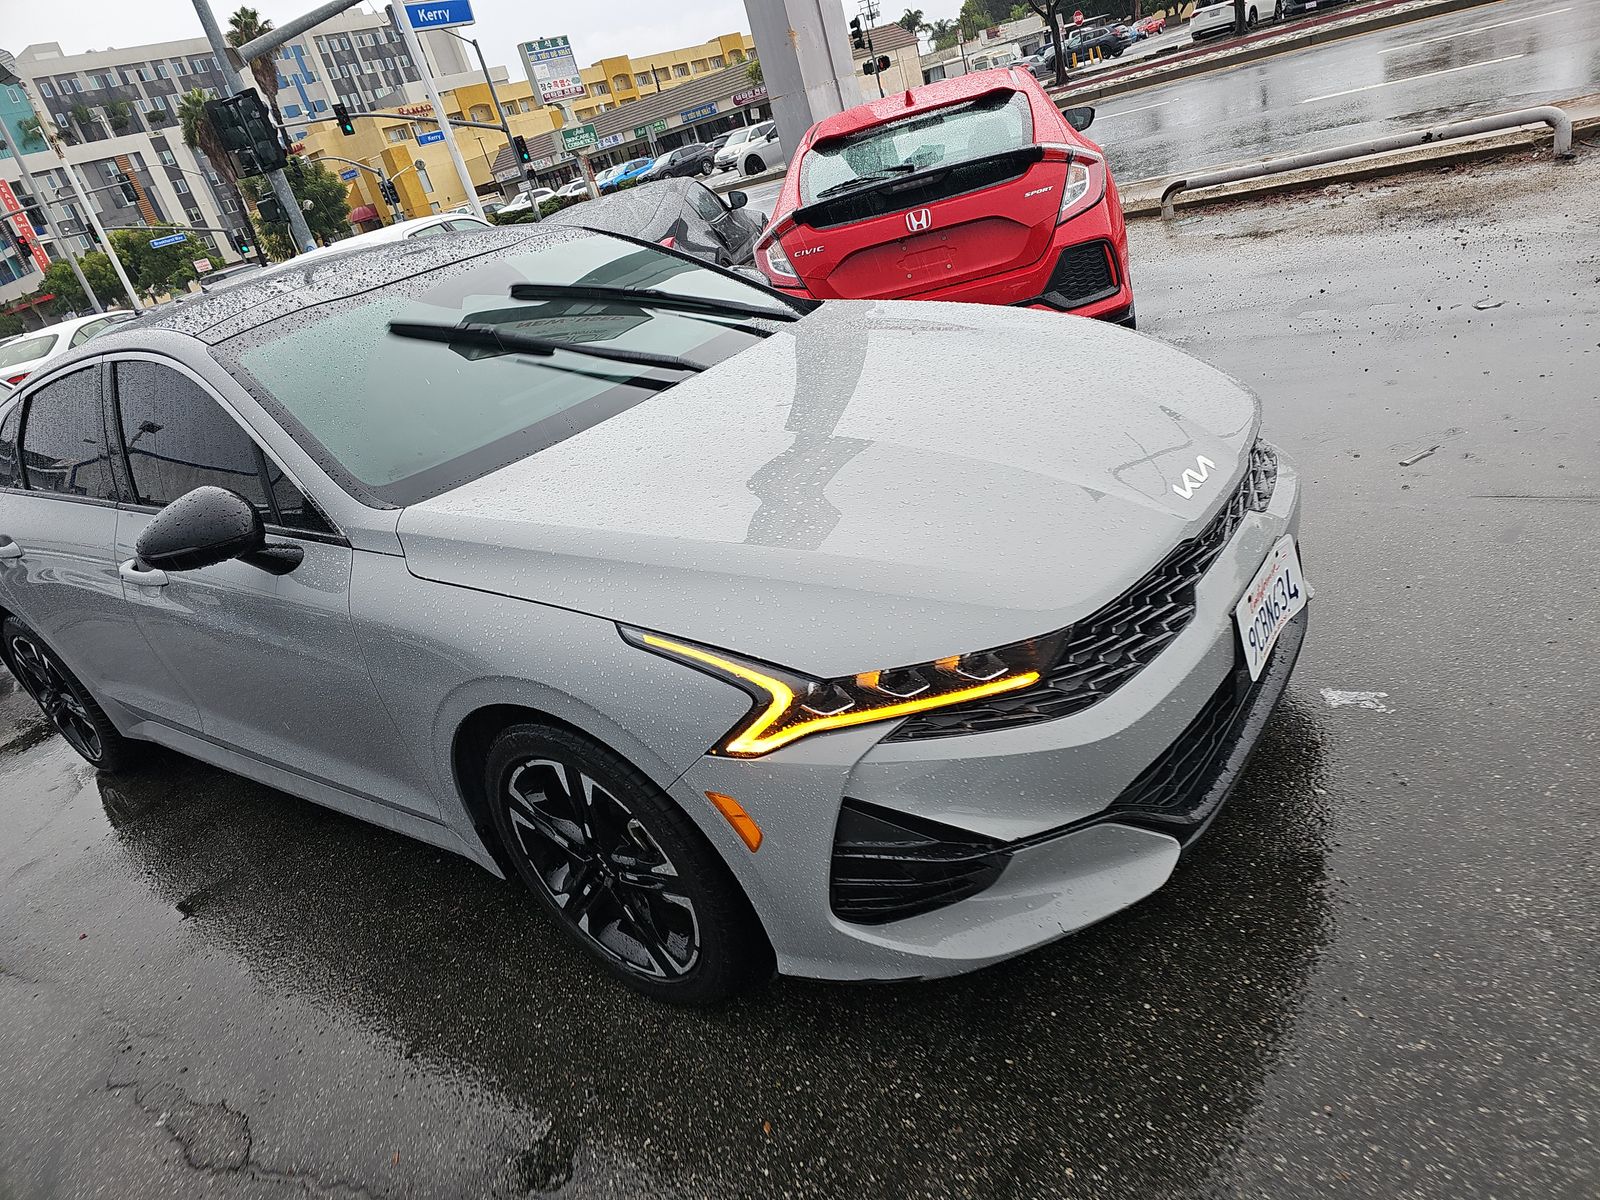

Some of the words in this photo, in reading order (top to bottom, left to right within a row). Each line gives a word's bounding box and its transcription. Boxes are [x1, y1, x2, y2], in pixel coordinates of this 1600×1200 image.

[417, 9, 450, 22] Kerry
[398, 104, 433, 115] RAMAD
[565, 133, 590, 143] SKINCARE
[568, 138, 596, 148] COSMETICS
[1024, 185, 1054, 197] SPORT
[794, 245, 824, 257] CIVIC
[1249, 569, 1299, 666] 9CBN634
